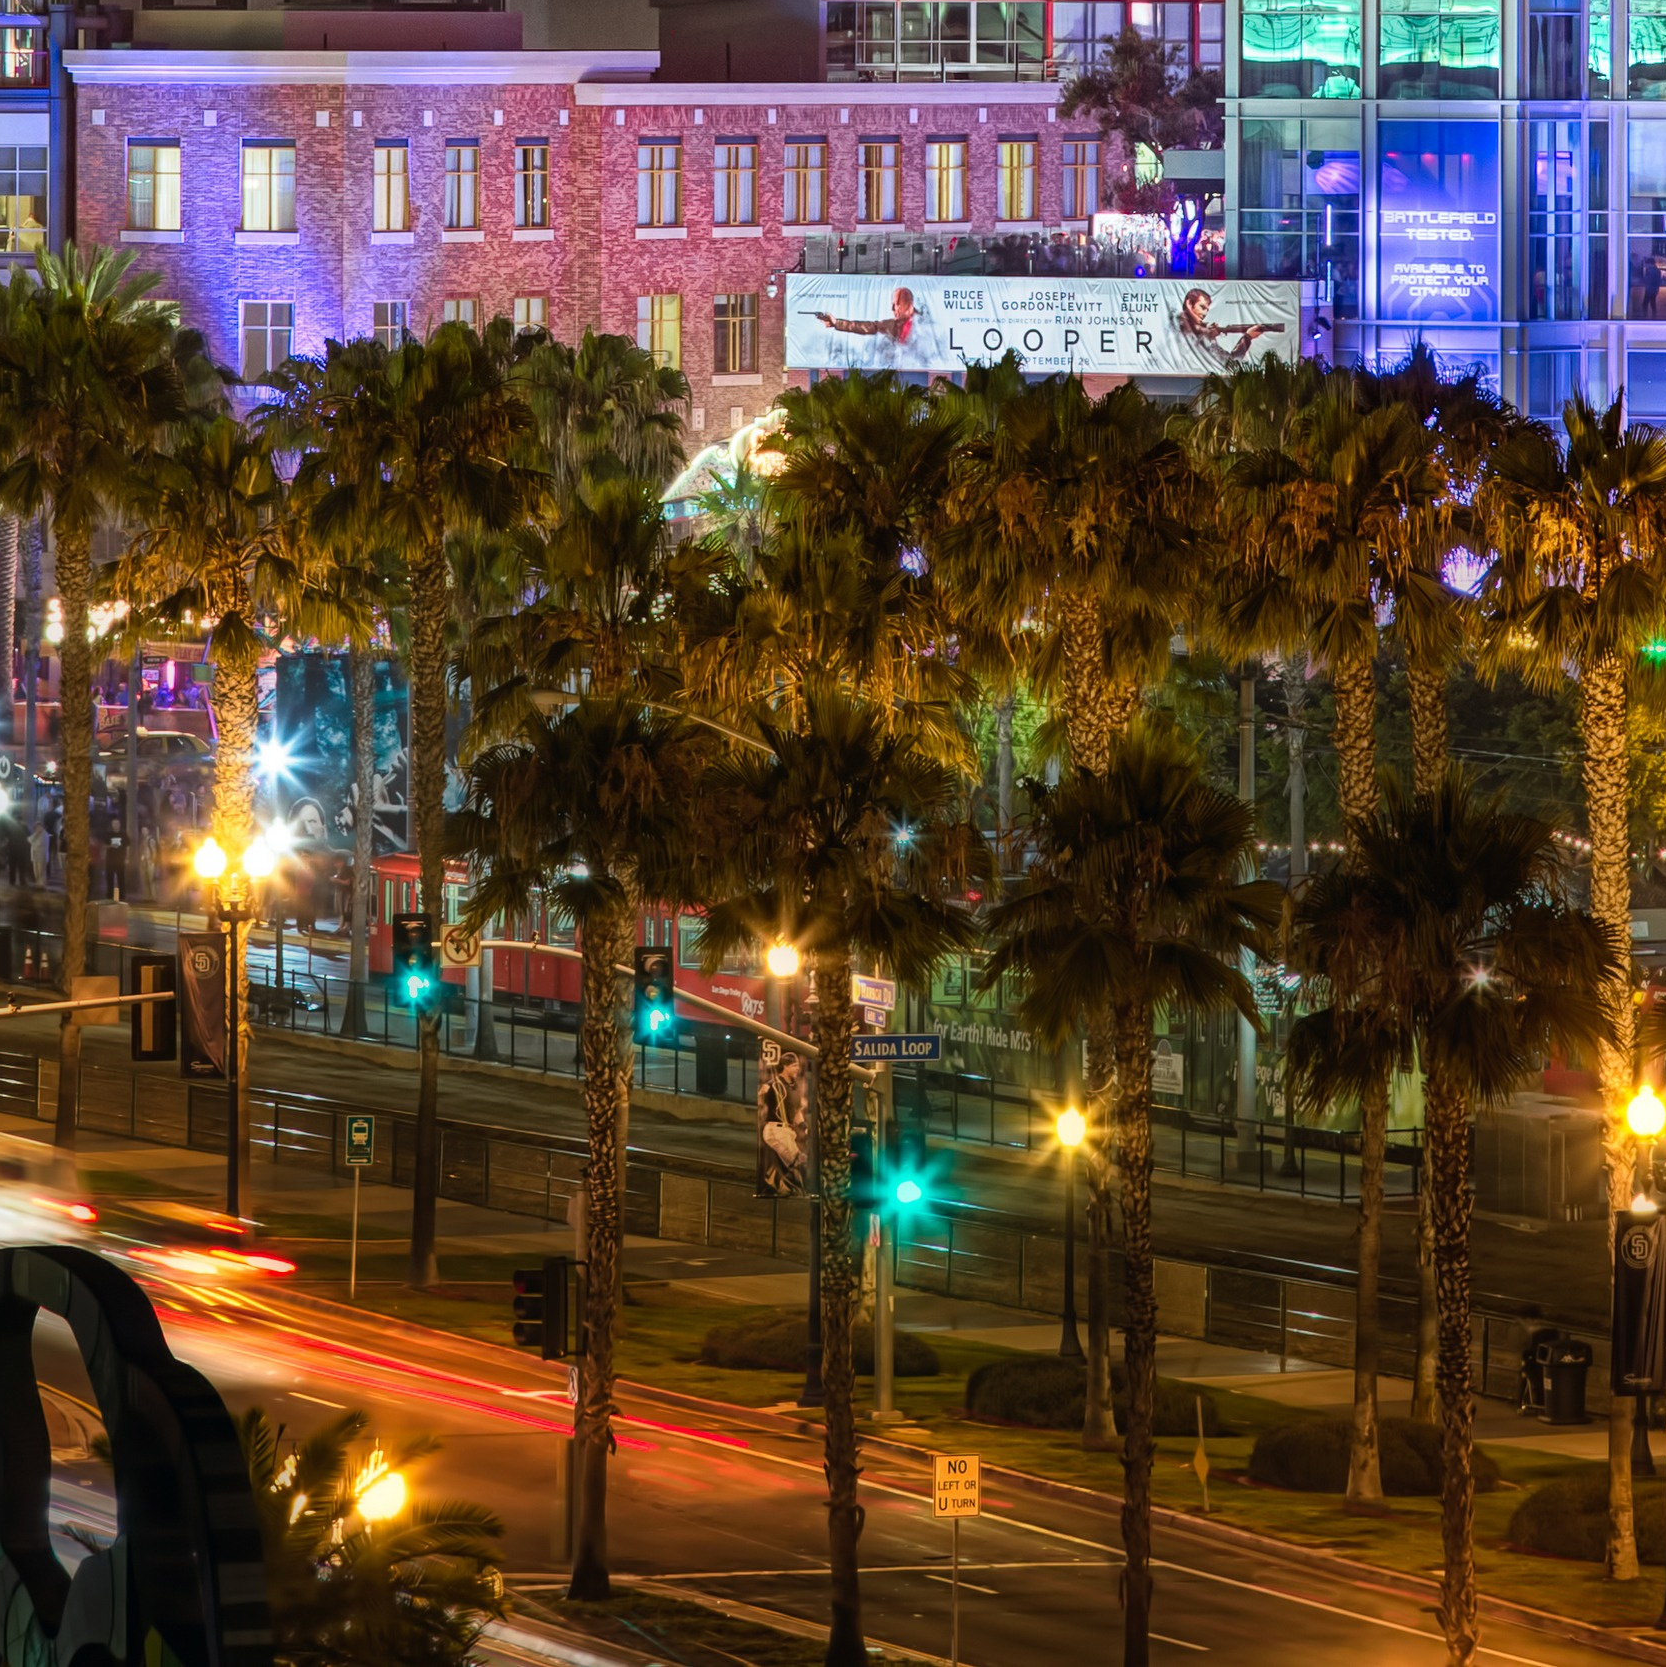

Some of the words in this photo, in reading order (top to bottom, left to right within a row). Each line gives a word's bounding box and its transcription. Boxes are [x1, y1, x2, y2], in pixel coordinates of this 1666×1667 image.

[1383, 211, 1496, 224] BATTLEFIELD
[1405, 228, 1475, 241] TESTED.
[1393, 263, 1465, 274] AVAILABLE
[1468, 264, 1486, 274] TO
[1391, 275, 1451, 285] PROTECT
[1454, 276, 1489, 286] YOUR
[943, 290, 983, 300] BRUCE
[1028, 291, 1076, 301] JOSEPH
[1122, 292, 1157, 302] EMILY
[1409, 286, 1439, 297] CITY
[1441, 287, 1471, 297] NOW
[944, 300, 984, 310] WILLIS
[1001, 301, 1103, 312] GORDON-LEVITT
[1121, 302, 1159, 313] BLUNT
[1054, 315, 1083, 325] RIAN
[1087, 316, 1143, 326] JOHNSON
[949, 327, 1153, 354] LOOPER
[950, 1020, 984, 1045] Earth!
[986, 1025, 1009, 1048] Ride
[854, 1040, 897, 1056] SALIDA
[901, 1039, 933, 1056] LOOP
[948, 1459, 968, 1474] NO
[937, 1480, 960, 1491] LEFT
[963, 1480, 977, 1490] OR
[938, 1497, 948, 1511] U
[951, 1498, 976, 1509] TURN
